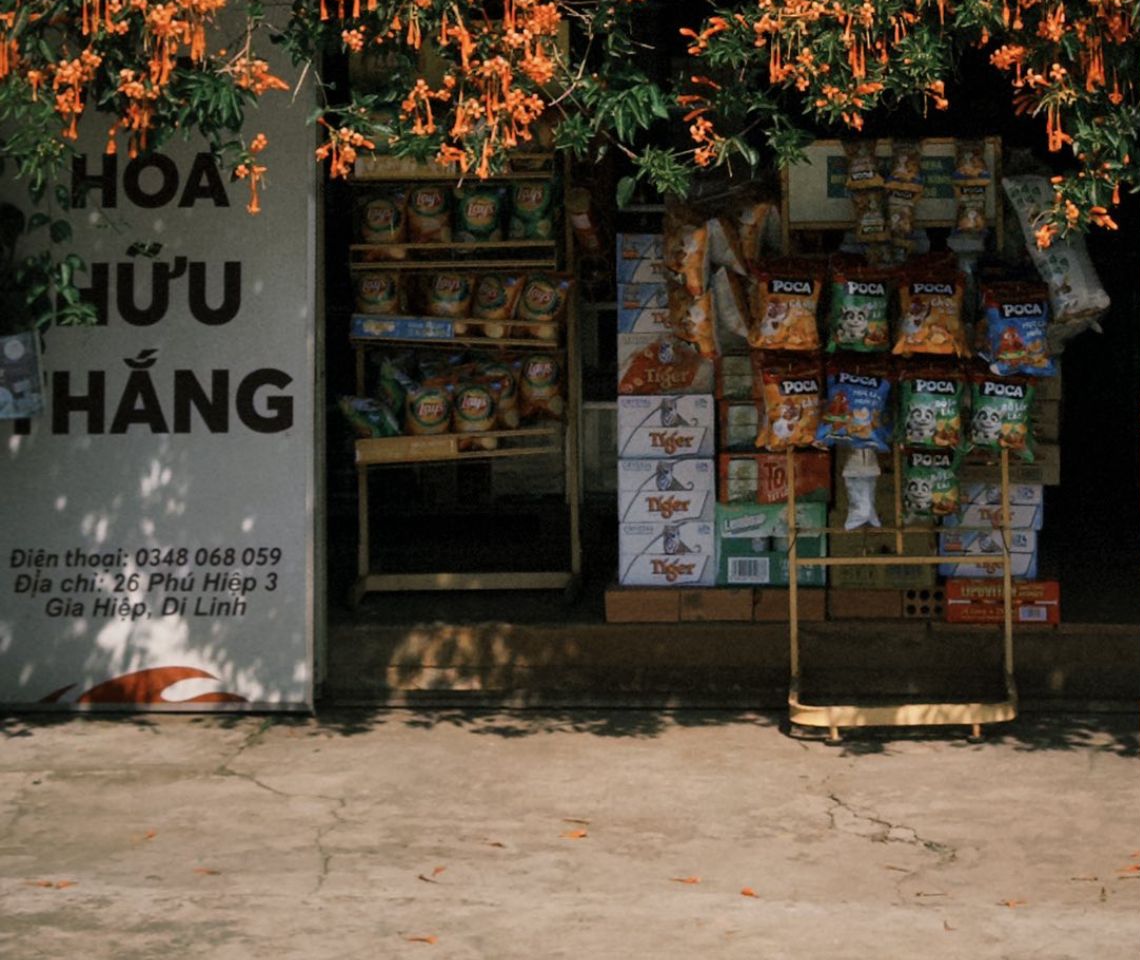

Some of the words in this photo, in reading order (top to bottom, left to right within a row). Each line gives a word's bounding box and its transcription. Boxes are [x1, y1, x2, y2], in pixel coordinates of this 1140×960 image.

[70, 151, 231, 209] HOA
[771, 279, 812, 294] POCA
[847, 280, 885, 295] POCA
[912, 282, 953, 295] POCA
[1002, 303, 1043, 318] POCA
[782, 379, 819, 394] POCA
[838, 372, 878, 388] POCA
[916, 379, 955, 393] POCA
[13, 348, 294, 436] HẮNG
[983, 381, 1024, 398] POCA
[649, 430, 694, 455] Tiger
[911, 453, 951, 467] POCA
[645, 494, 690, 519] Tiger
[65, 547, 129, 574] thoại:
[135, 547, 189, 567] 0348
[194, 547, 236, 567] 068
[242, 547, 282, 567] 059
[651, 558, 696, 582] Tiger
[113, 572, 140, 593] 26
[147, 571, 195, 593] Phú
[202, 571, 257, 596] Hiệp
[264, 571, 279, 592] 3
[45, 597, 85, 618] Gia
[92, 596, 152, 622] Hiệp,
[161, 596, 187, 617] Di
[194, 596, 247, 617] Linh
